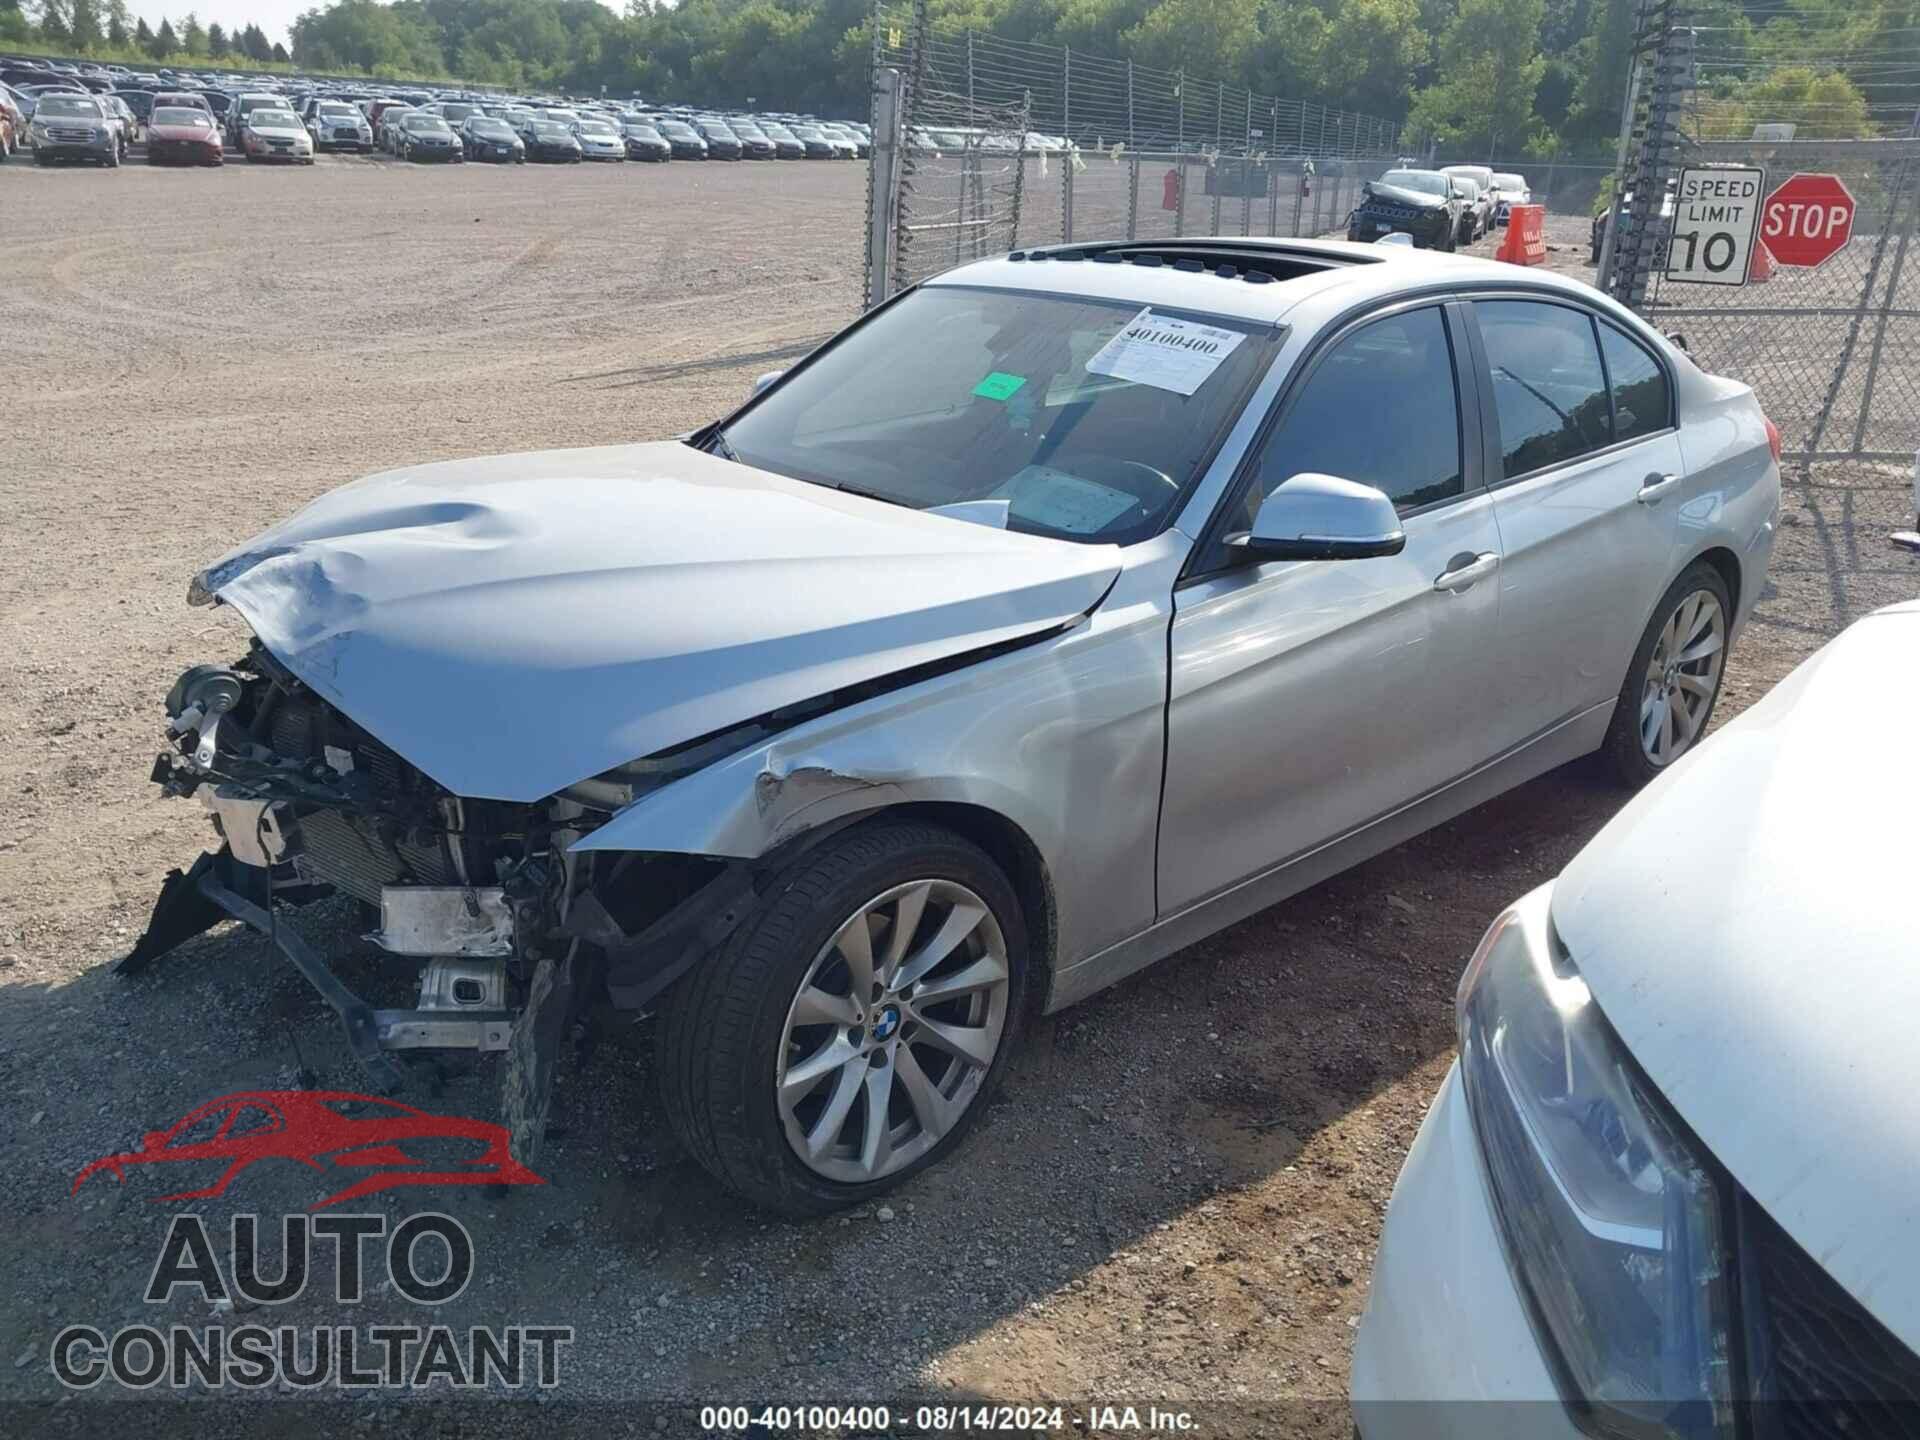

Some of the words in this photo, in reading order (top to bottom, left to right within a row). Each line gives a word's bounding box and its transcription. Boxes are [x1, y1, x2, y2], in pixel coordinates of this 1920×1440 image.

[1686, 181, 1754, 198] SPEED
[1689, 206, 1744, 222] LIMIT
[1766, 203, 1848, 239] STOP
[1682, 230, 1736, 273] 10
[1127, 328, 1218, 354] 40100400
